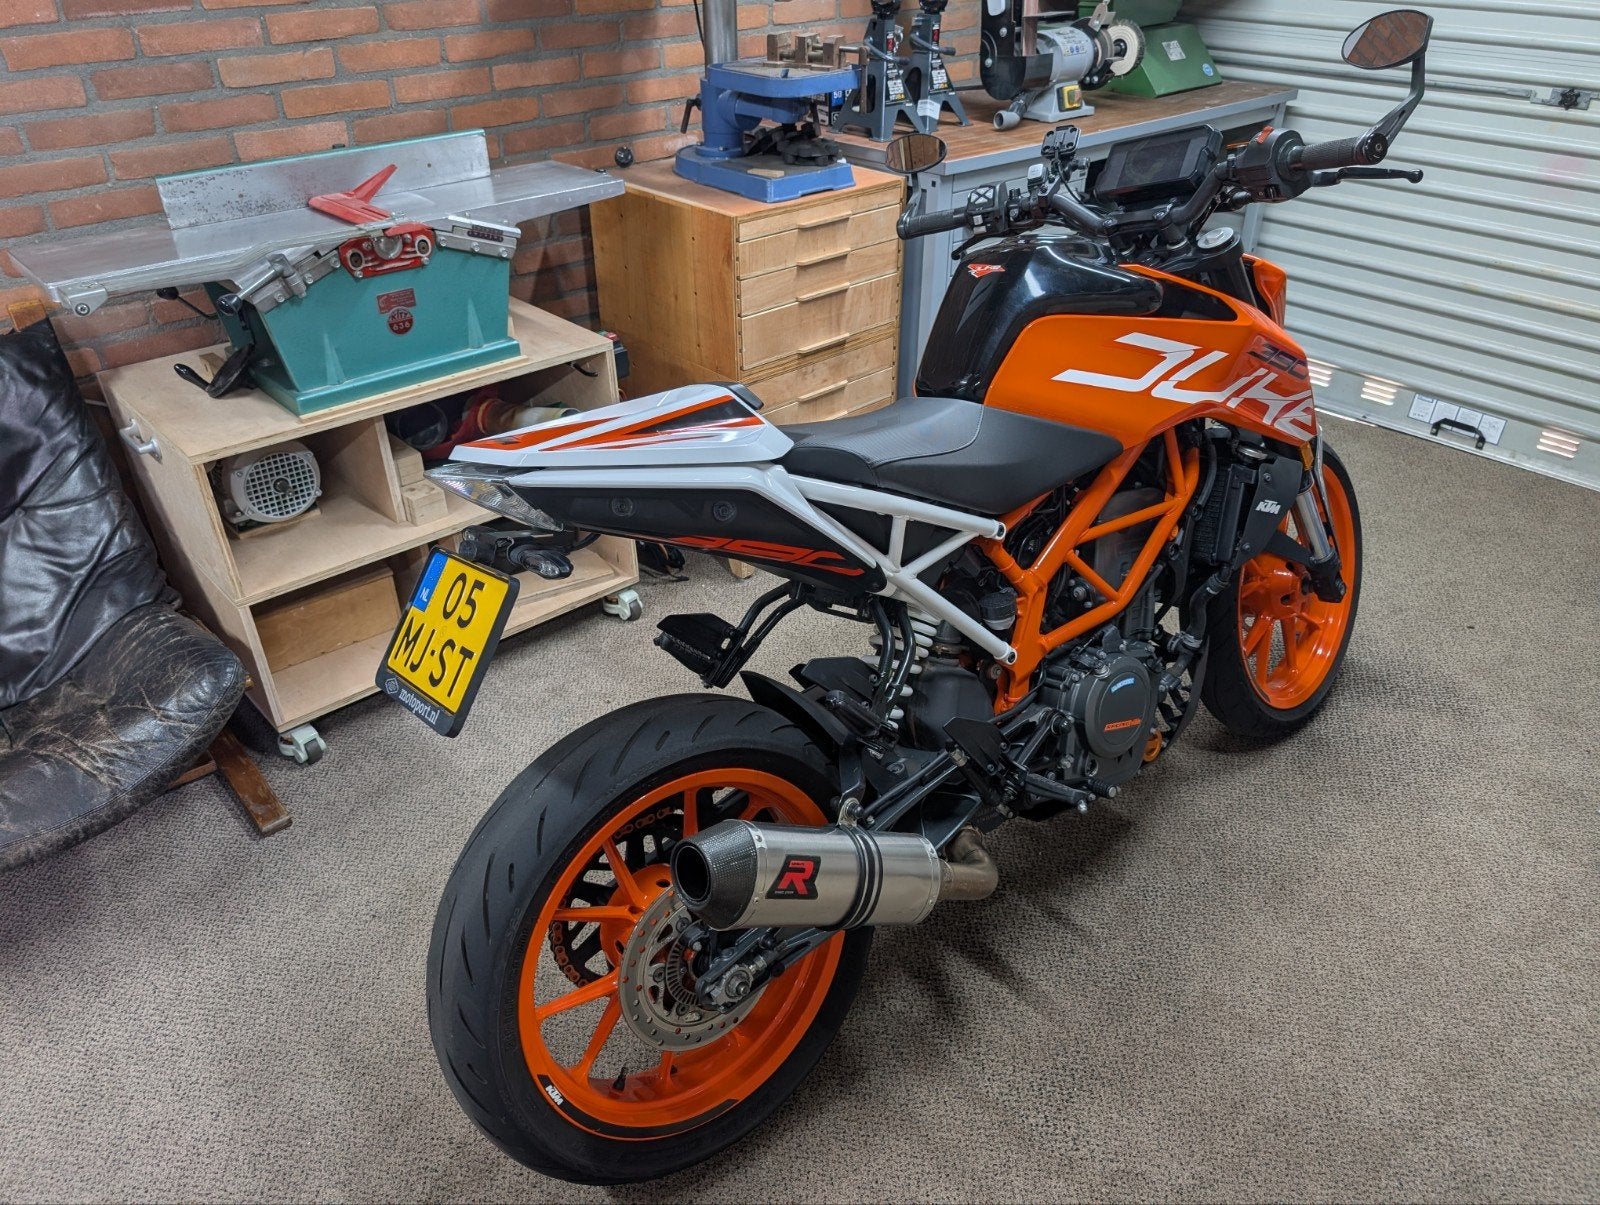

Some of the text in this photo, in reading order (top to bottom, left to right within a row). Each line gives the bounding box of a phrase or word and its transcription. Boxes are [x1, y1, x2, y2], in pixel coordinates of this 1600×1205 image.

[392, 321, 411, 331] 636
[1246, 342, 1309, 380] 390
[1255, 499, 1282, 515] KTM
[419, 586, 430, 603] NL
[442, 572, 485, 628] 05
[398, 688, 440, 725] motoport.nl
[777, 860, 814, 895] R
[545, 1084, 564, 1106] KTM
